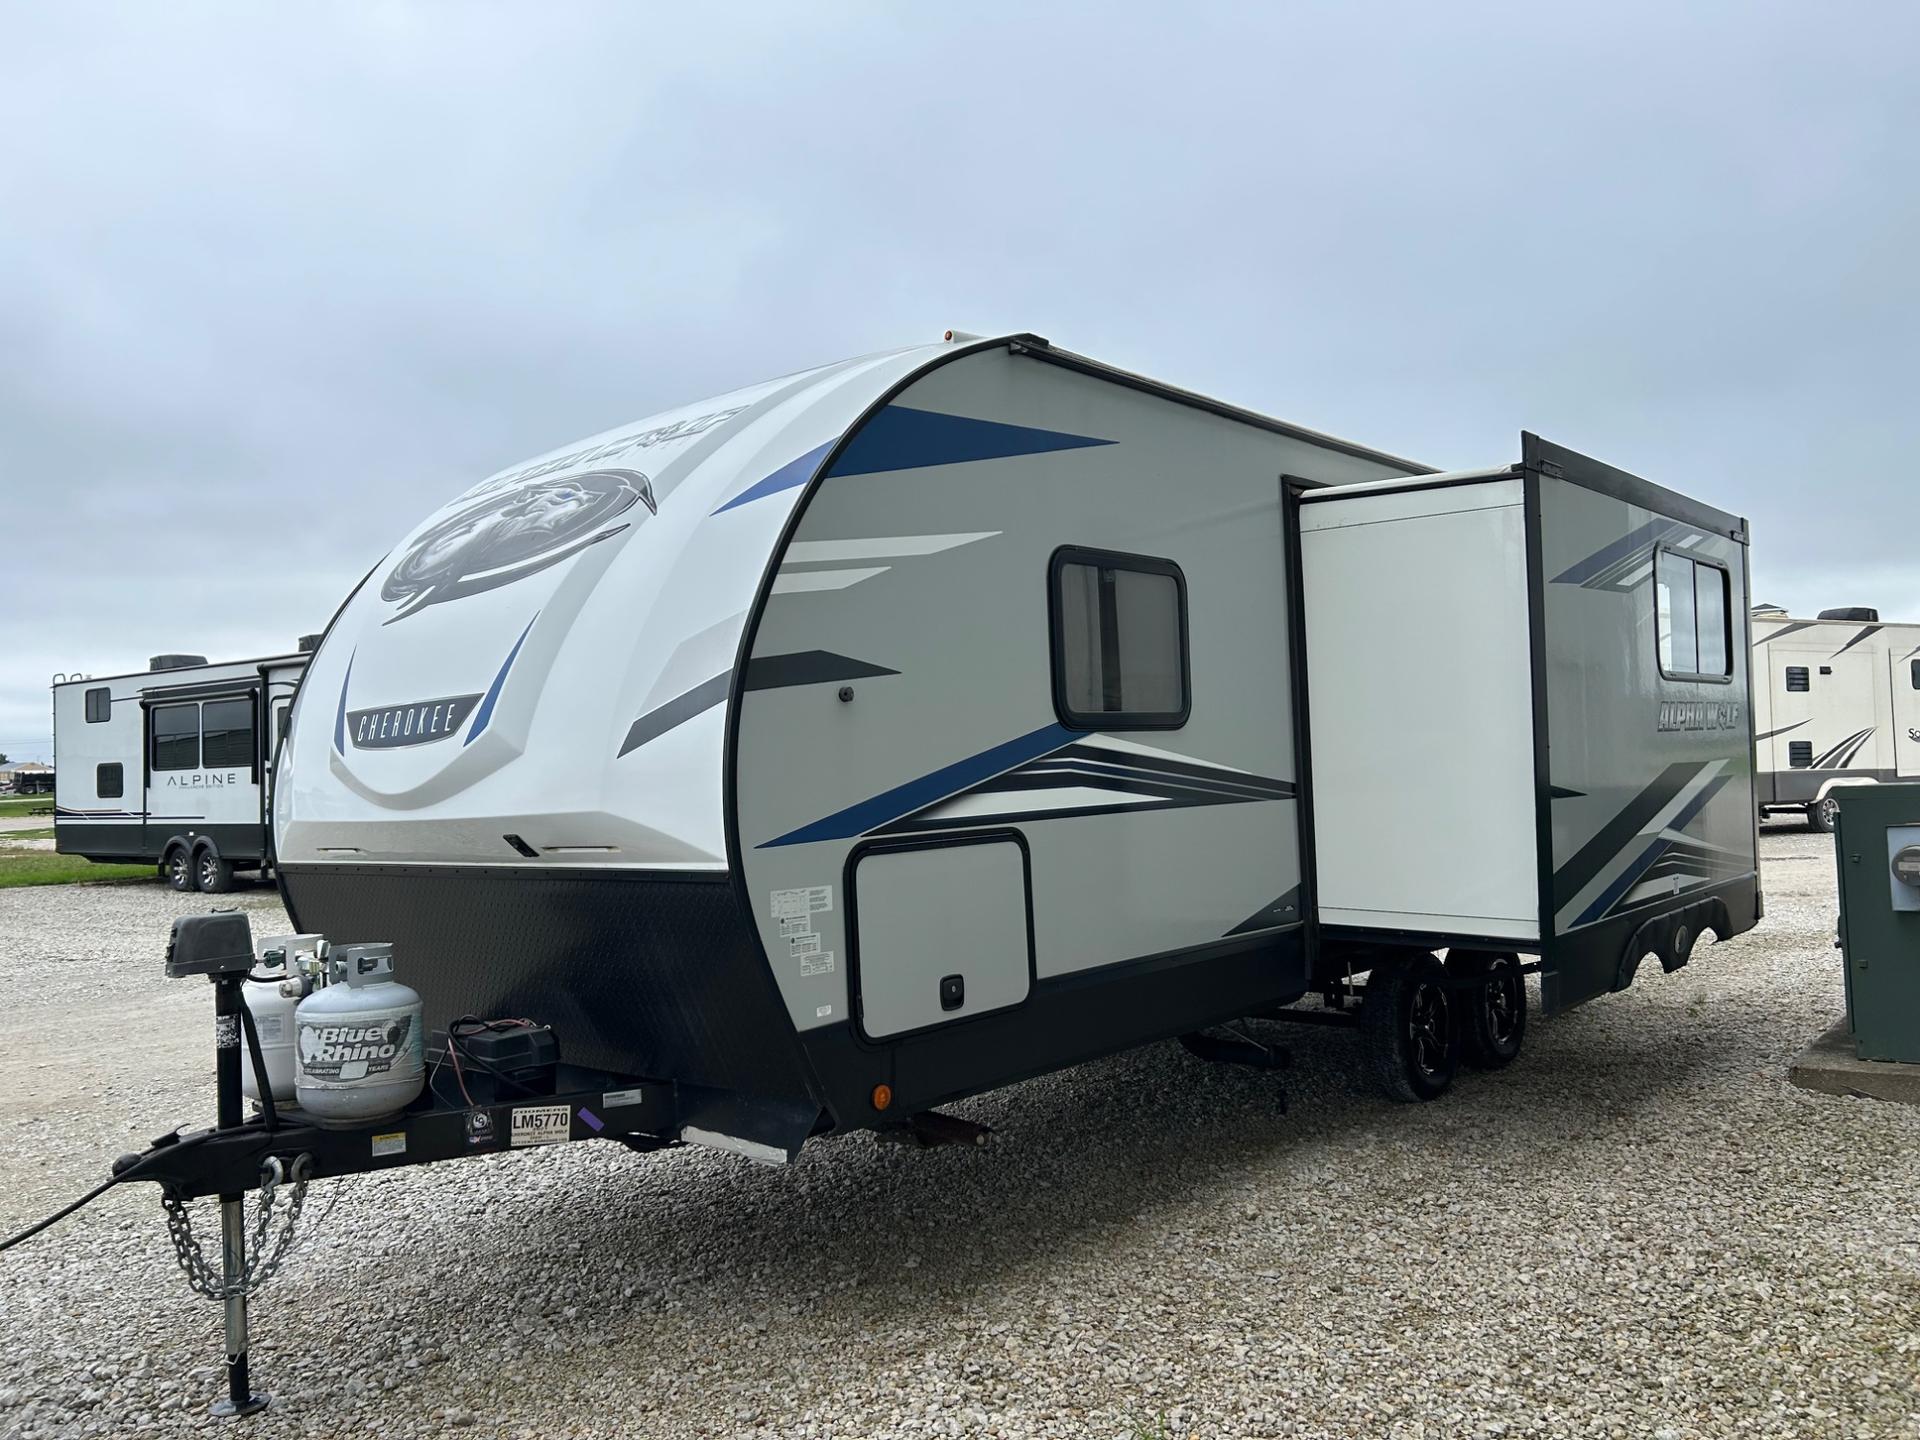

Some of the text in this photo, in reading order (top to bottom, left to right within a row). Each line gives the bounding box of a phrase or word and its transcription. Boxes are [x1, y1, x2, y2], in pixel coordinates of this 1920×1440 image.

[358, 704, 456, 742] CHEROKEE
[1657, 701, 1704, 732] ALPHA
[167, 773, 236, 786] ALPINE
[319, 1026, 382, 1043] Blue
[316, 1043, 396, 1061] Rhino
[513, 1112, 568, 1129] LM5770
